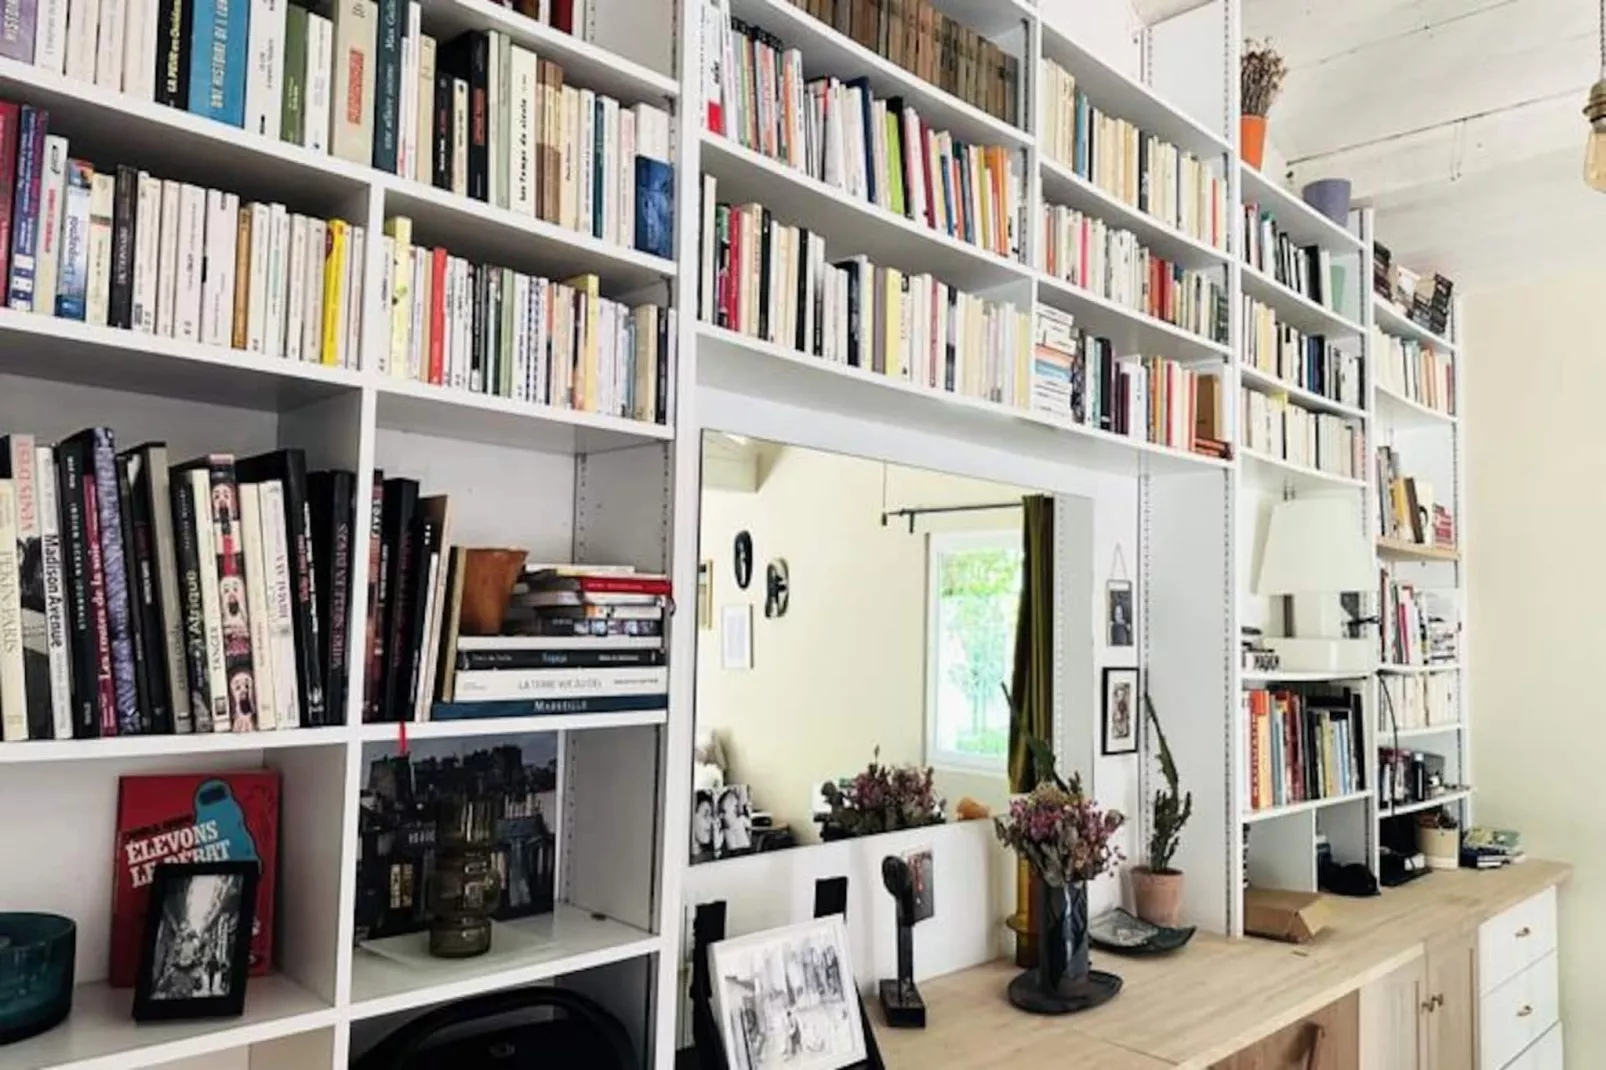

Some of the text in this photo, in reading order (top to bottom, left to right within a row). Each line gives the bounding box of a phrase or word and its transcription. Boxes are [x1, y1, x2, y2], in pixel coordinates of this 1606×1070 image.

[171, 39, 180, 52] en
[384, 28, 395, 52] Max
[168, 52, 179, 79] PEUR
[211, 42, 226, 86] HISTOIRE
[167, 80, 177, 93] LA
[210, 88, 224, 109] UNE
[519, 150, 528, 183] Temps
[519, 187, 527, 201] Les
[70, 503, 80, 539] INDIAN
[73, 542, 82, 576] OCEAN
[44, 534, 64, 648] Madison Avenue
[90, 572, 102, 586] la
[92, 590, 105, 607] de
[97, 609, 110, 653] routes
[98, 655, 111, 682] Les
[126, 820, 218, 864] ÉLEVONS
